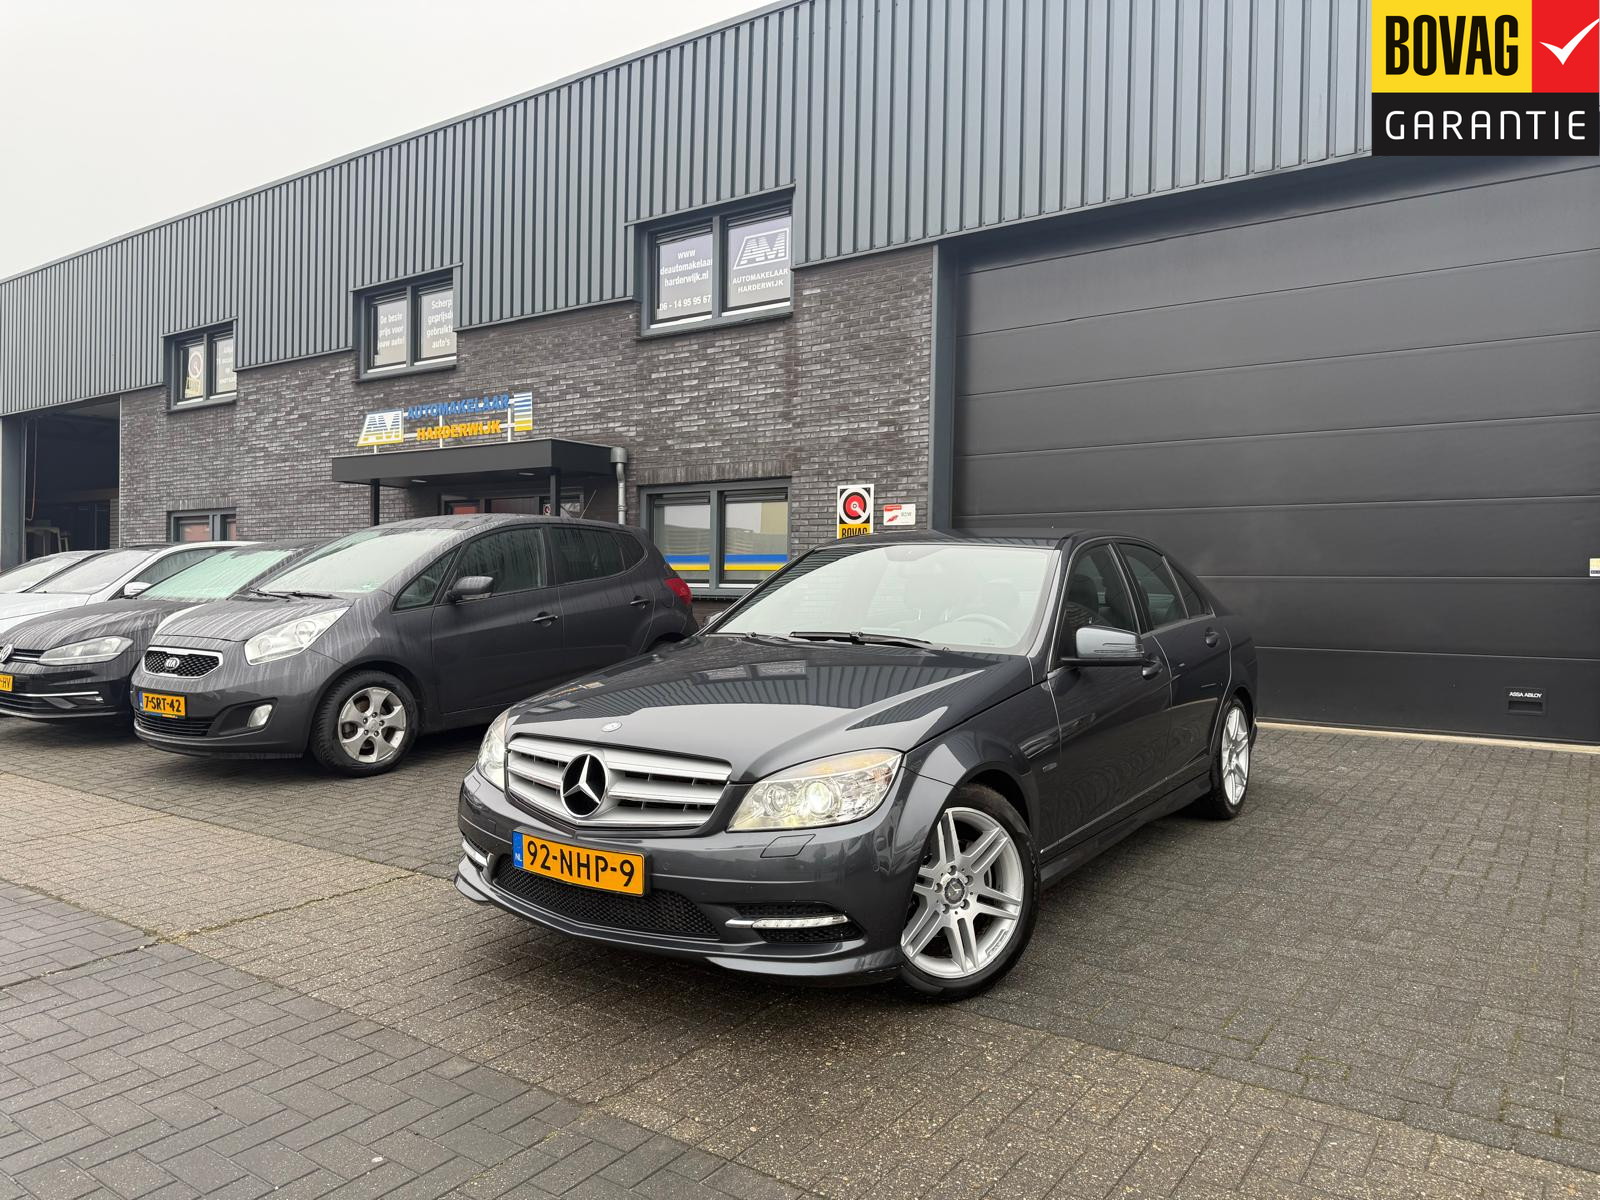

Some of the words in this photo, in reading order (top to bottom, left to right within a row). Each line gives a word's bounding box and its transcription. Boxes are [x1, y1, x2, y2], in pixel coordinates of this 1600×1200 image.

[678, 249, 696, 259] www
[664, 270, 709, 287] harderwijk.nl
[732, 268, 789, 285] AUTOMAKELAAR
[737, 280, 784, 294] HARDERWIJK
[674, 299, 682, 309] 14
[683, 298, 692, 307] 95
[693, 296, 702, 306] 95
[407, 393, 510, 420] AUTOMAKELAAR
[416, 419, 501, 441] HARDERWIJK
[144, 695, 182, 713] 7-SRT-42
[527, 840, 635, 887] 92-NHP-9
